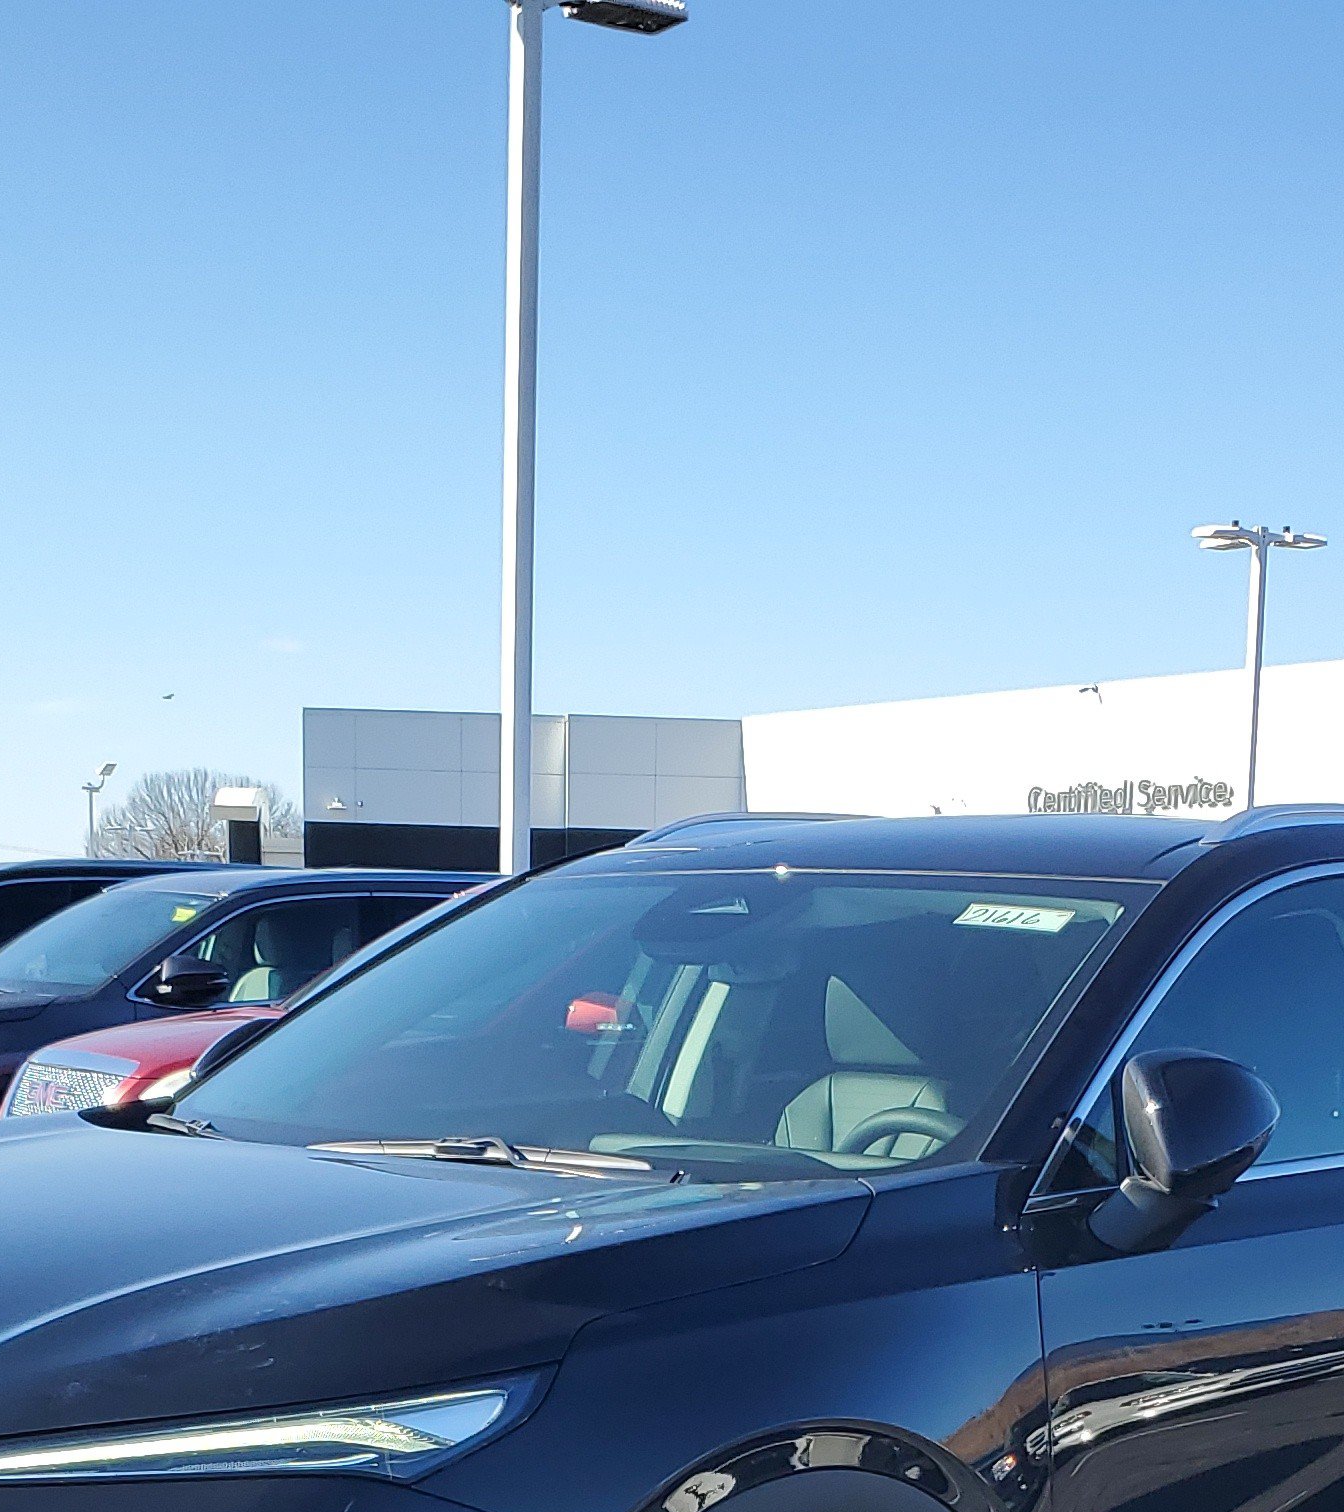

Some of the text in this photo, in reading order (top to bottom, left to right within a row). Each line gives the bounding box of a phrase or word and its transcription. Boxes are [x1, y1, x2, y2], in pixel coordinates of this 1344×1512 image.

[1027, 776, 1235, 814] Certified Service
[956, 908, 1041, 925] 21616
